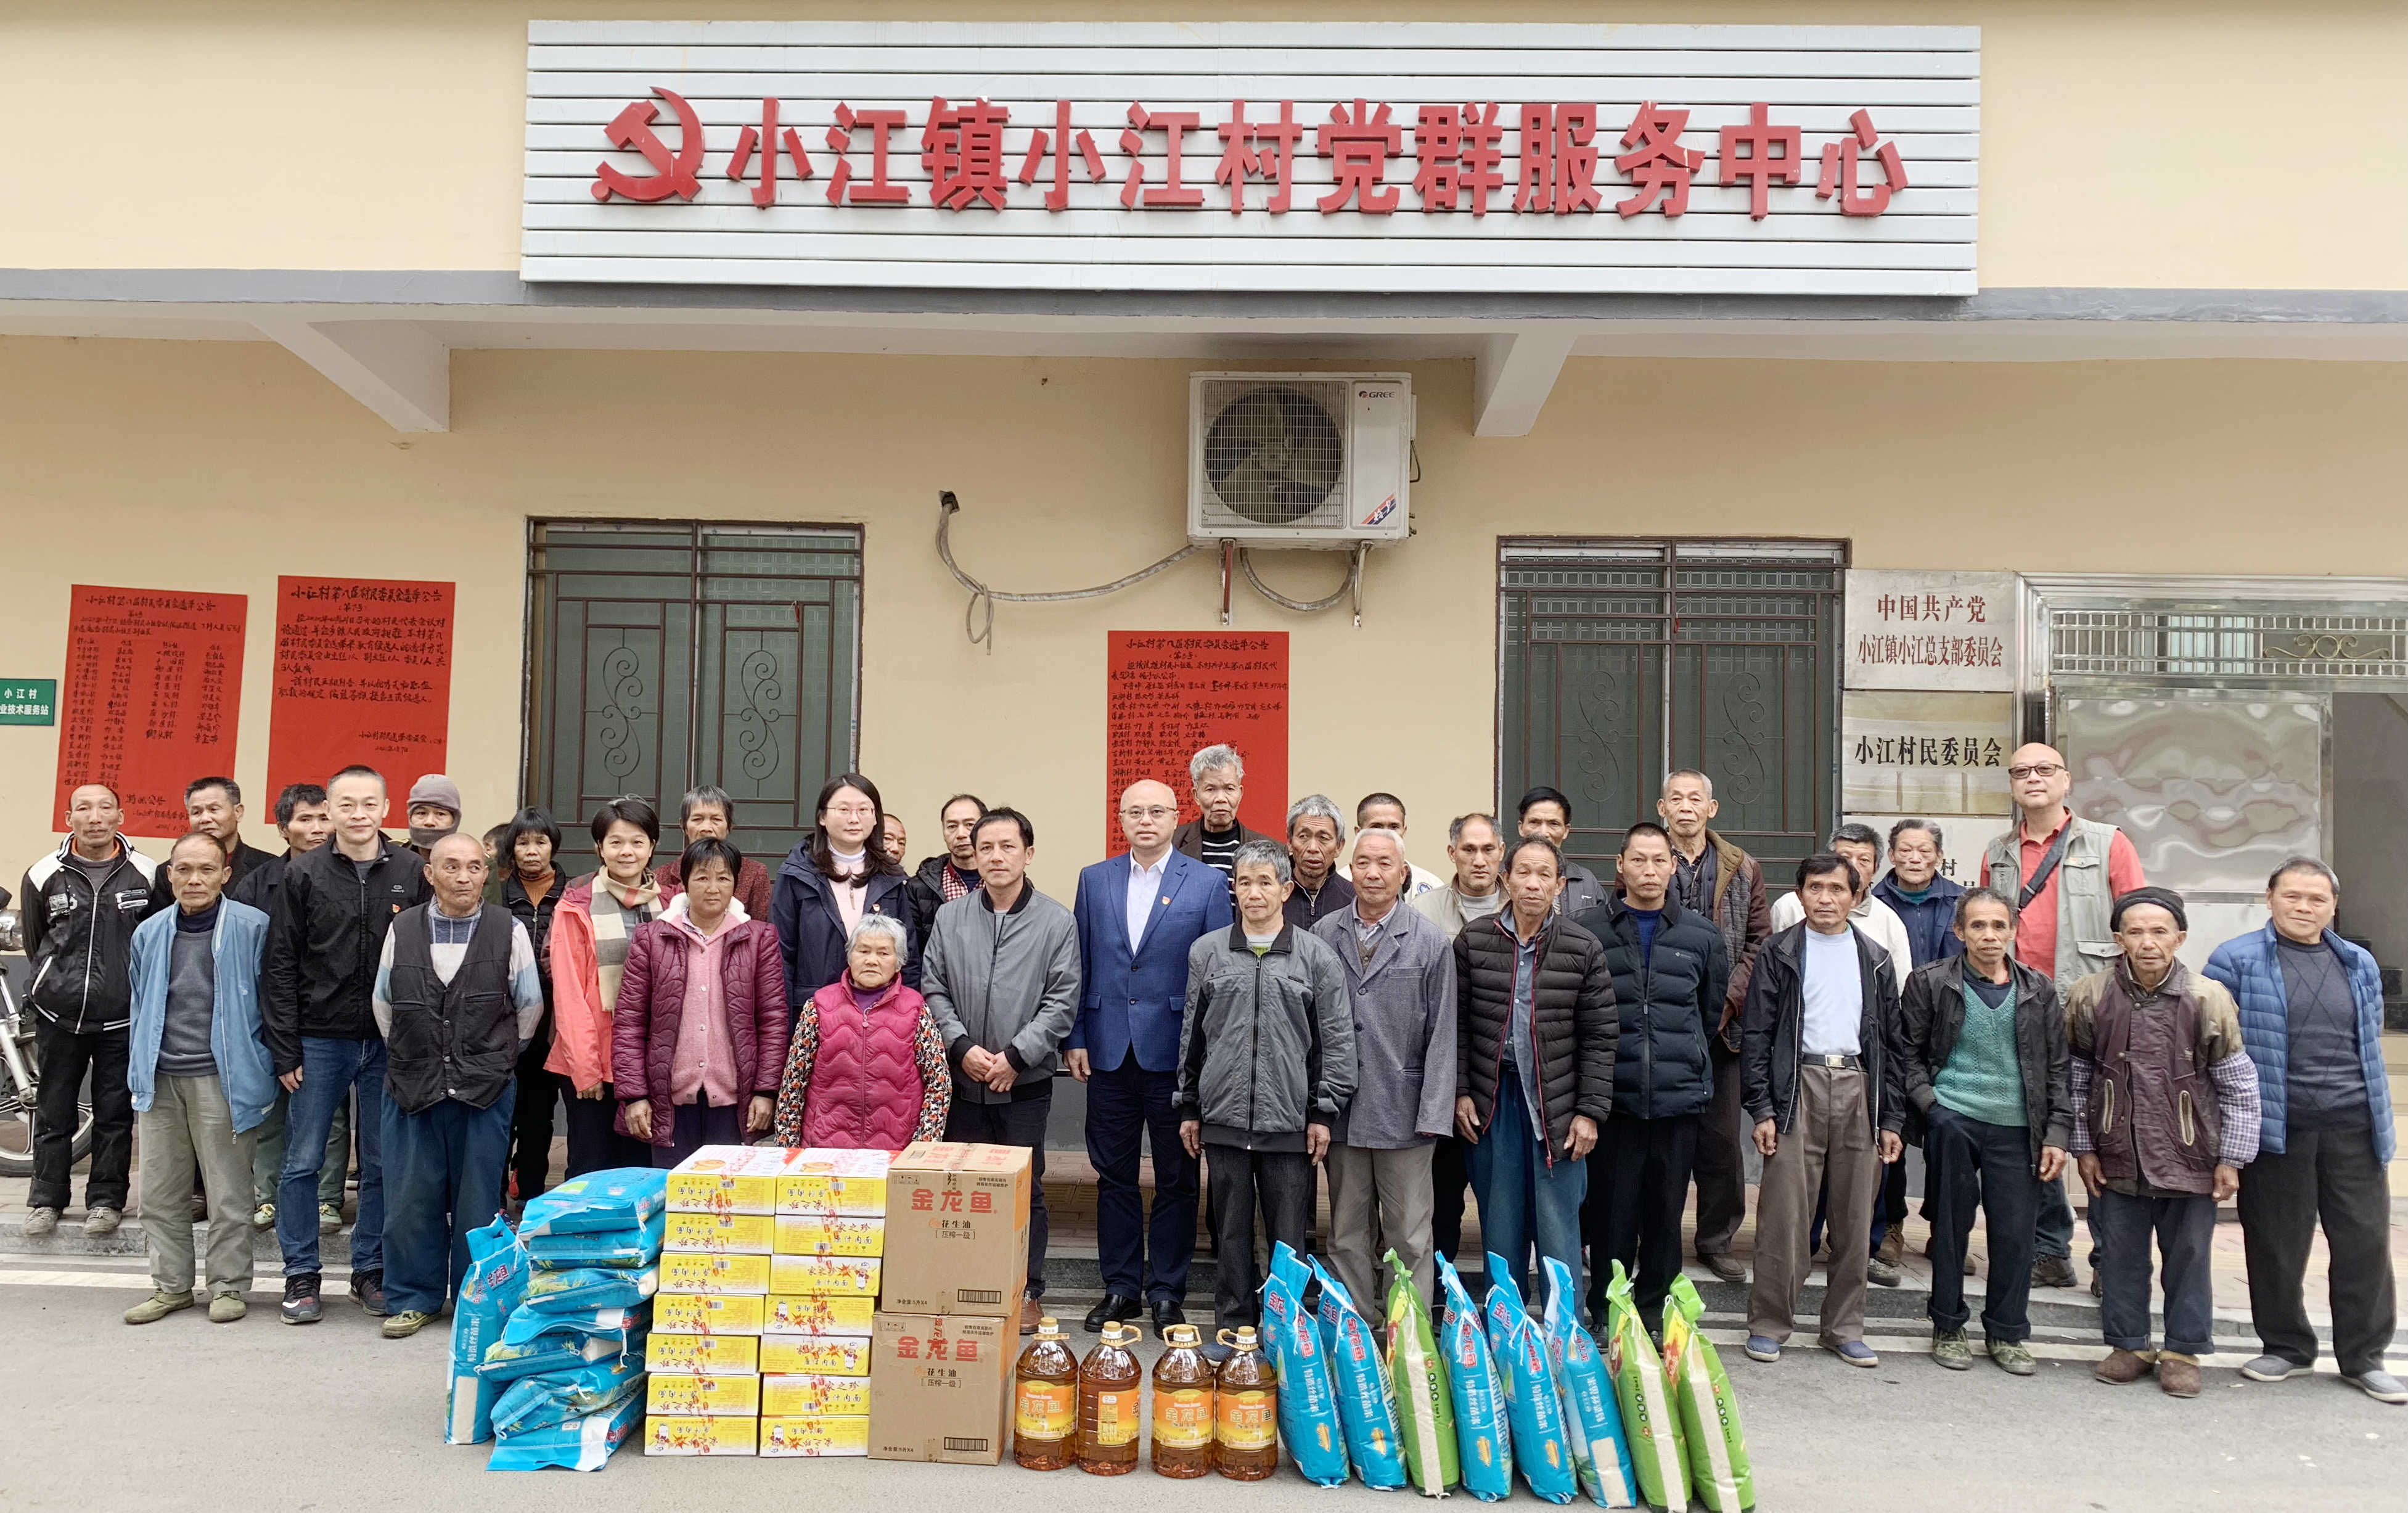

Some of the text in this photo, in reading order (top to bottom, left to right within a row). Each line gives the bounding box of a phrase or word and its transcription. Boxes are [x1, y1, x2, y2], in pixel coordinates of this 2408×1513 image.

[726, 96, 1909, 220] 小江镇小江村党群服务中心
[1369, 391, 1396, 399] GREE
[1878, 594, 1986, 623] 中国共产党
[1858, 634, 2004, 667] 小江镇小江总支部委员会
[4, 687, 37, 699] 小江村
[0, 703, 49, 716] 业技术服务站
[1855, 735, 2002, 767] 小江村民委员会
[911, 1189, 993, 1214] 金龙鱼
[941, 1220, 972, 1229] 花生油
[897, 1336, 978, 1363] 金龙鱼
[927, 1367, 957, 1377] 花生油
[1020, 1396, 1060, 1413] 金龙鱼
[1165, 1406, 1208, 1422] 金龙鱼
[1230, 1408, 1272, 1424] 金龙鱼
